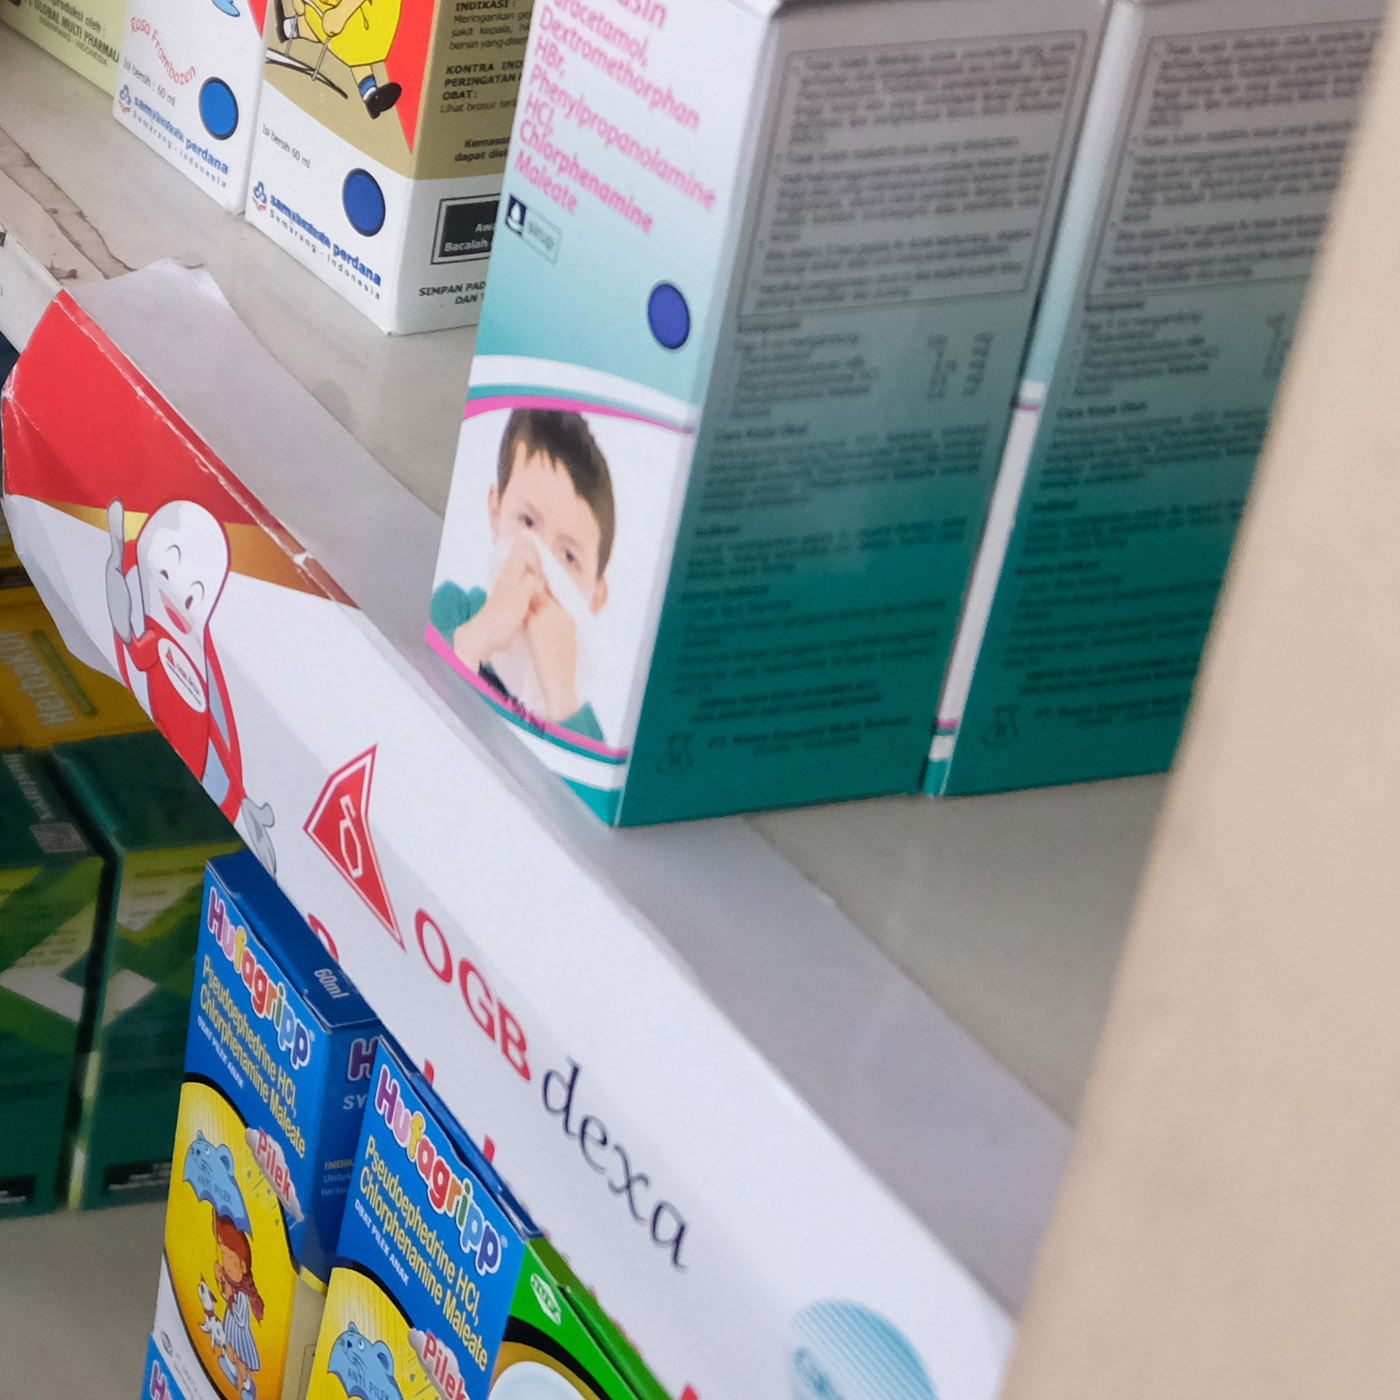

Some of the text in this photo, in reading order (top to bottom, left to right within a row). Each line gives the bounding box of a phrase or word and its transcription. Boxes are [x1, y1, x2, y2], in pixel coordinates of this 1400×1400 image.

[61, 16, 83, 40] MULTI
[534, 39, 566, 78] HBr,
[539, 4, 700, 130] Dextromethorphan
[185, 138, 230, 175] perdana
[513, 150, 579, 215] Maleate
[519, 120, 654, 234] Chlorphenamine
[529, 64, 718, 211] Phenylpropanolamine
[331, 240, 382, 288] perdana
[203, 954, 276, 1081] Pseudoephedrine
[207, 886, 312, 1070] Hufagripp
[313, 967, 349, 1000] 60ml
[200, 986, 306, 1159] Chlorphenamine Maleate
[413, 907, 690, 1272] OGB dexa
[256, 1128, 292, 1202] Pilek
[365, 1134, 455, 1285] Pseudoephedrine
[374, 1064, 502, 1276] Hufagripp
[360, 1165, 488, 1373] Chlorphenamine Maleate
[422, 1332, 468, 1400] Pilek
